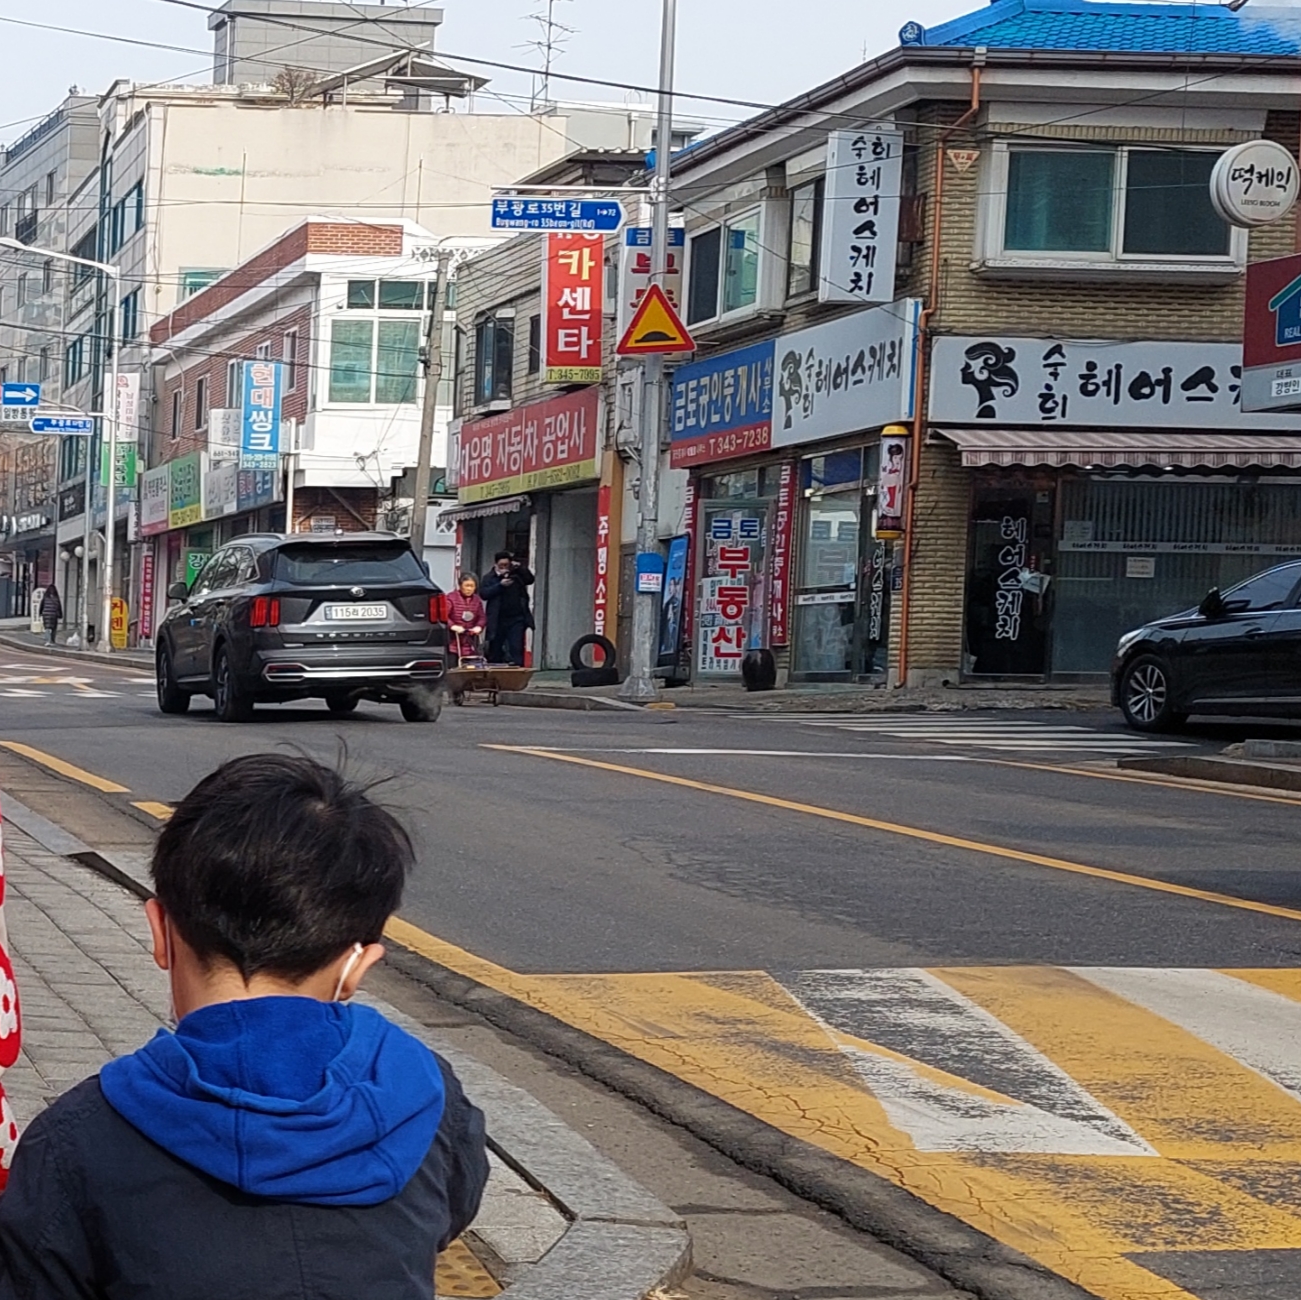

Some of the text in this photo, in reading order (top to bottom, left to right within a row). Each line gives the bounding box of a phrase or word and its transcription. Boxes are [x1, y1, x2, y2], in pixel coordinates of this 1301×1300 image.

[1231, 163, 1292, 195] 떡케익
[495, 200, 582, 218] 부광로35번길
[495, 217, 540, 229] Bugwang-ro
[849, 165, 882, 295] 헤어스케치
[556, 247, 595, 359] 카센타
[815, 340, 901, 398] 헤어스케치
[496, 420, 538, 472] 자동차
[542, 407, 587, 463] 공업사
[717, 426, 769, 454] 343-7238
[711, 518, 761, 540] 금토
[711, 546, 751, 660] 부동산
[995, 516, 1027, 641] 헤어스케치
